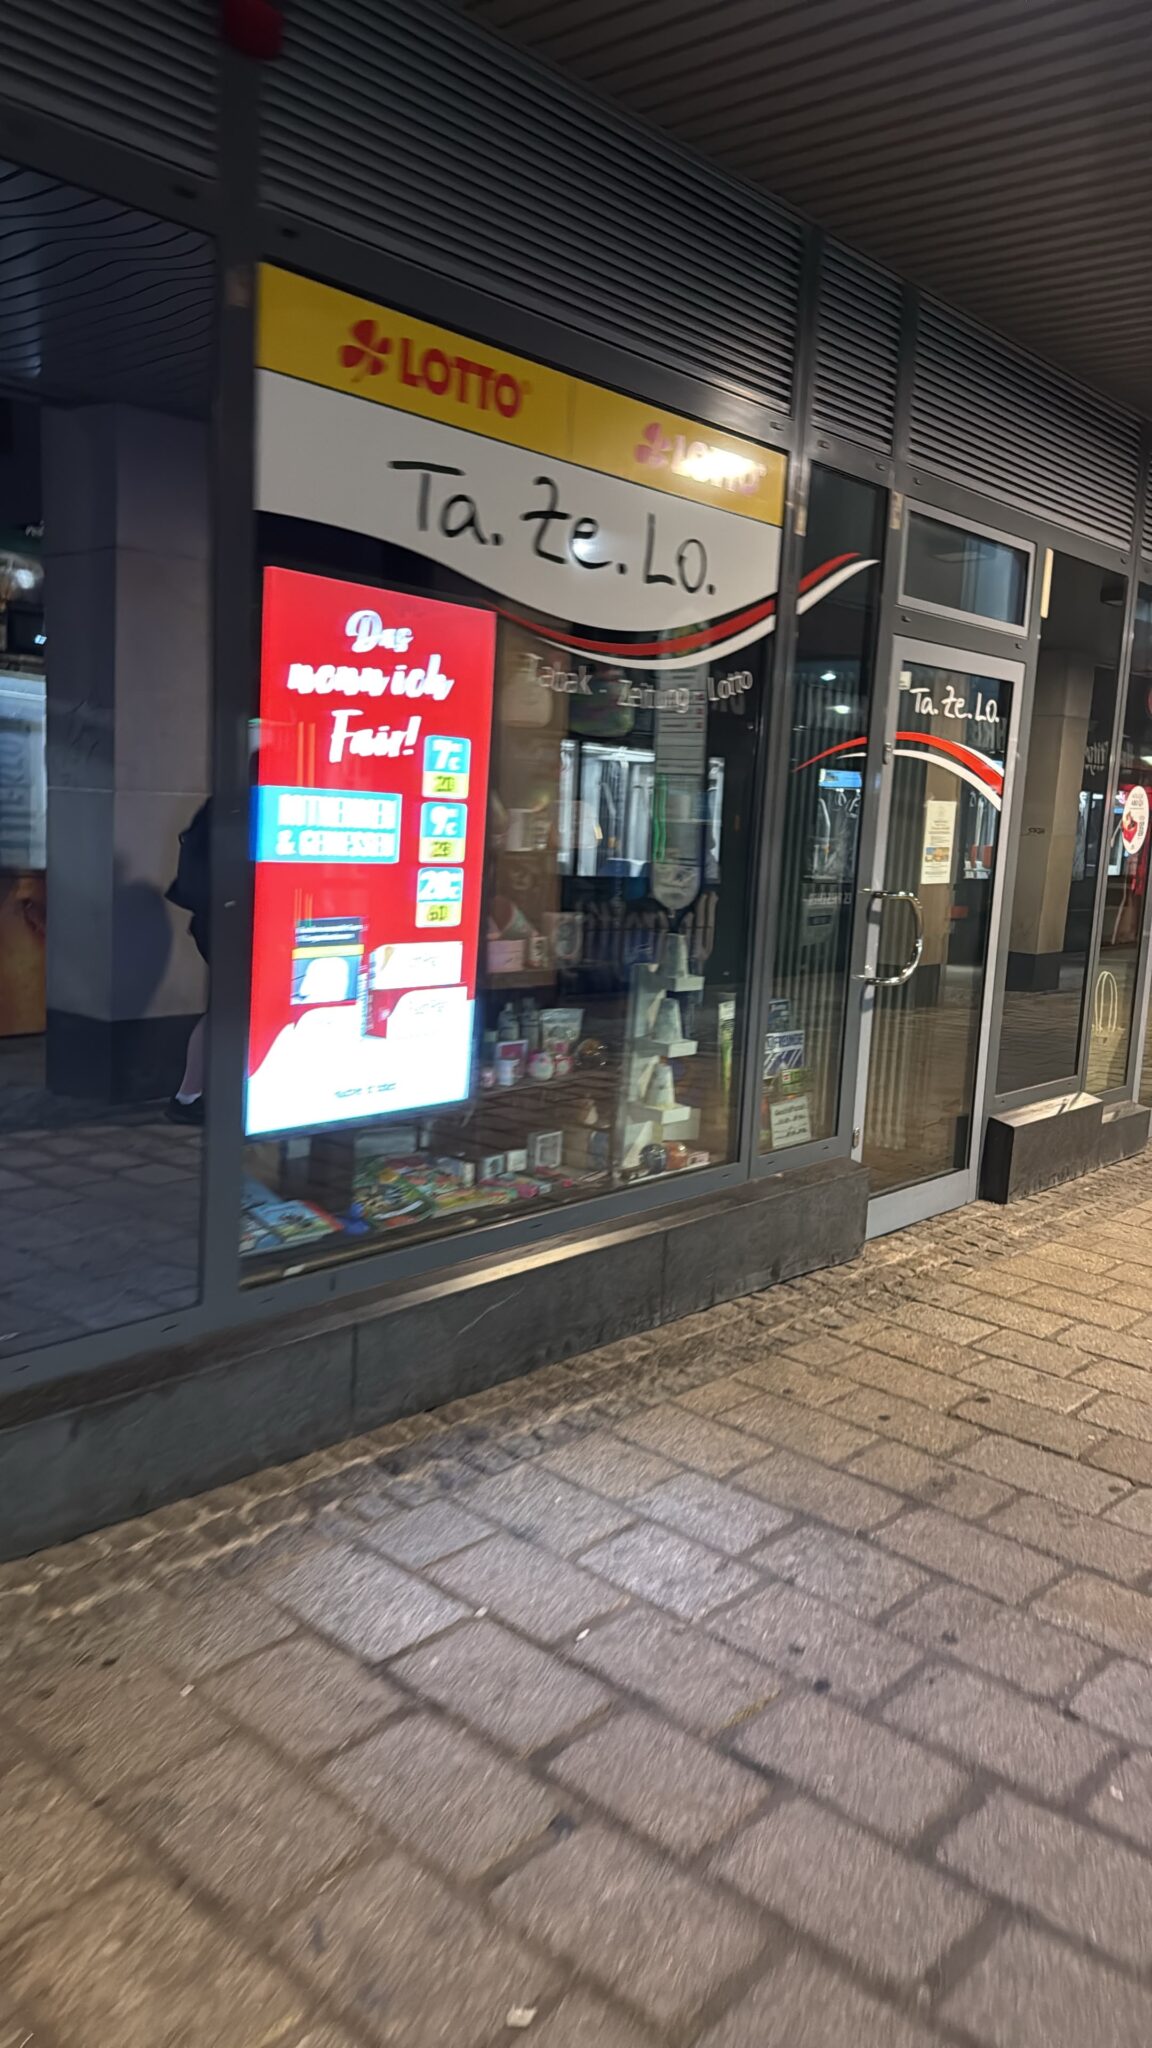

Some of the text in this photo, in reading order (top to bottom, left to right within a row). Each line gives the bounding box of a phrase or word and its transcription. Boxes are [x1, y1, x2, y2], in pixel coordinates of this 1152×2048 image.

[398, 337, 523, 419] LOTTO
[670, 433, 763, 495] LOO
[344, 609, 414, 653] Das
[390, 653, 455, 701] ich
[524, 652, 594, 696] Tabak
[706, 670, 754, 702] Lotto
[328, 708, 423, 764] Fair!
